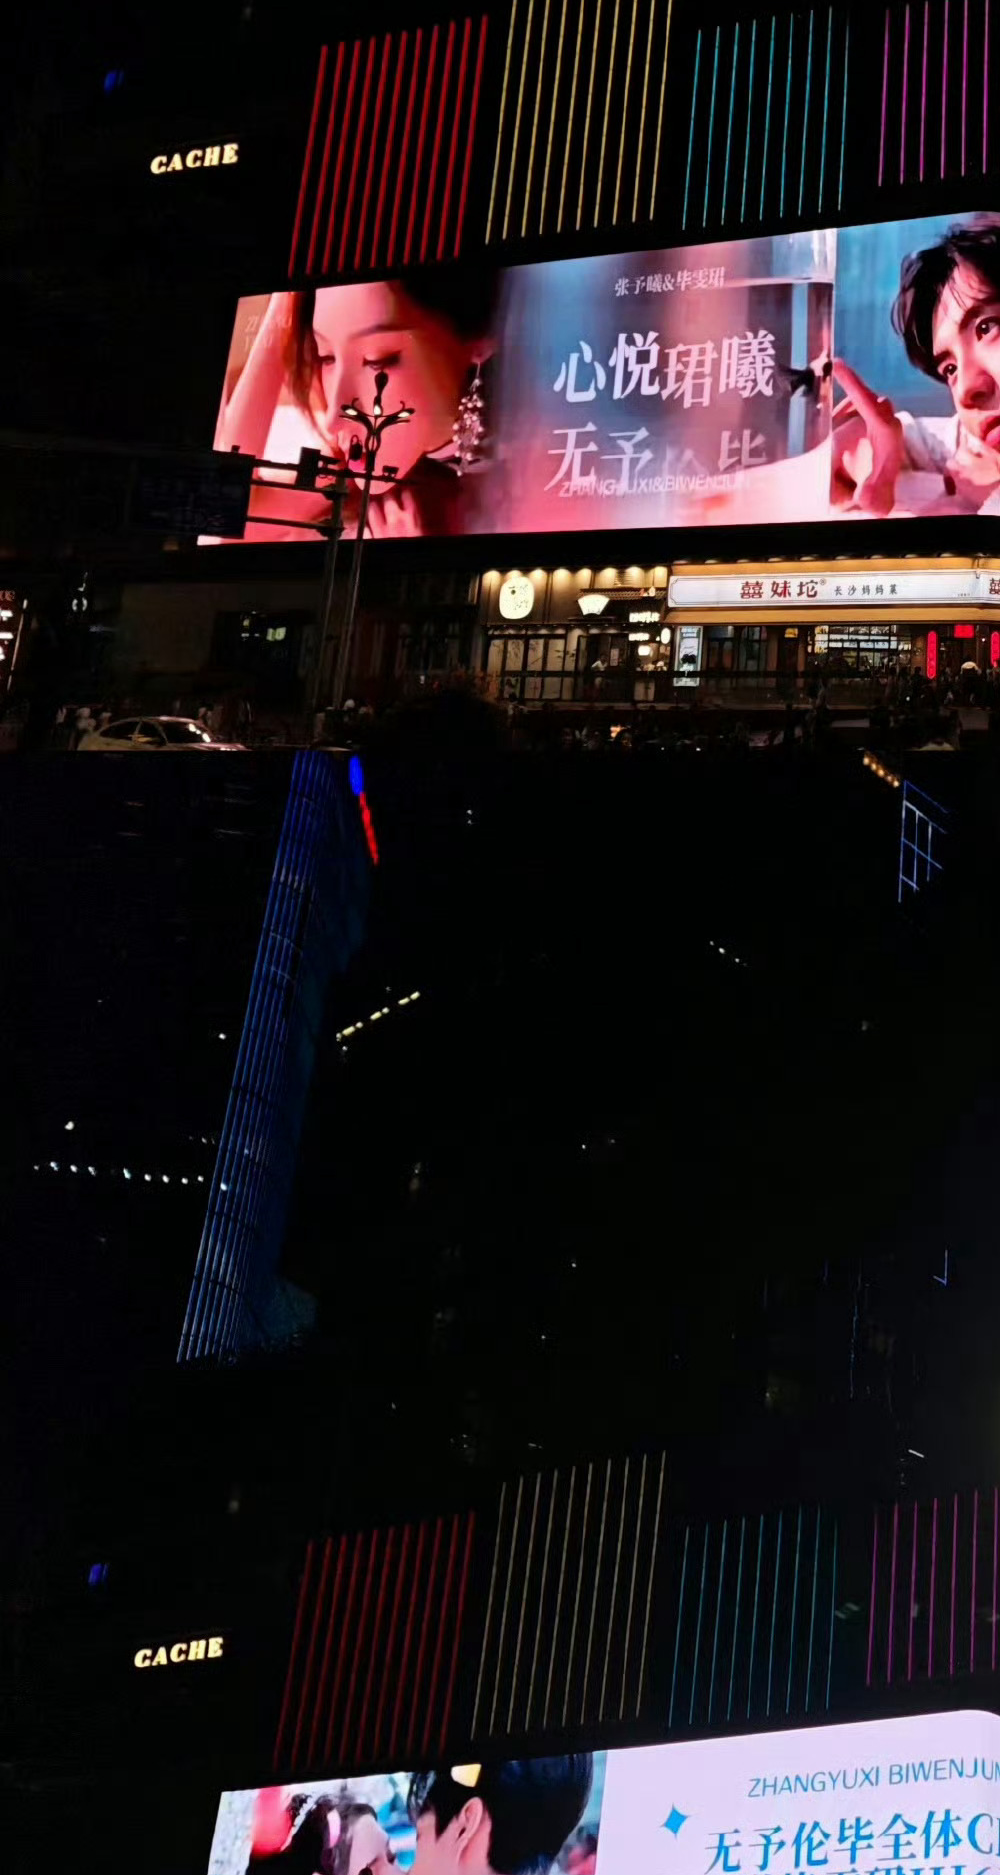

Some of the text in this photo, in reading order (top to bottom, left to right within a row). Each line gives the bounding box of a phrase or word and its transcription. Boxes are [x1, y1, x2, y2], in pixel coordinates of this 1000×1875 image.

[149, 142, 238, 175] CACHE
[553, 330, 776, 409] 心悦珺曦
[134, 1636, 223, 1669] CACHE
[747, 1764, 880, 1798] ZHANGYUXI
